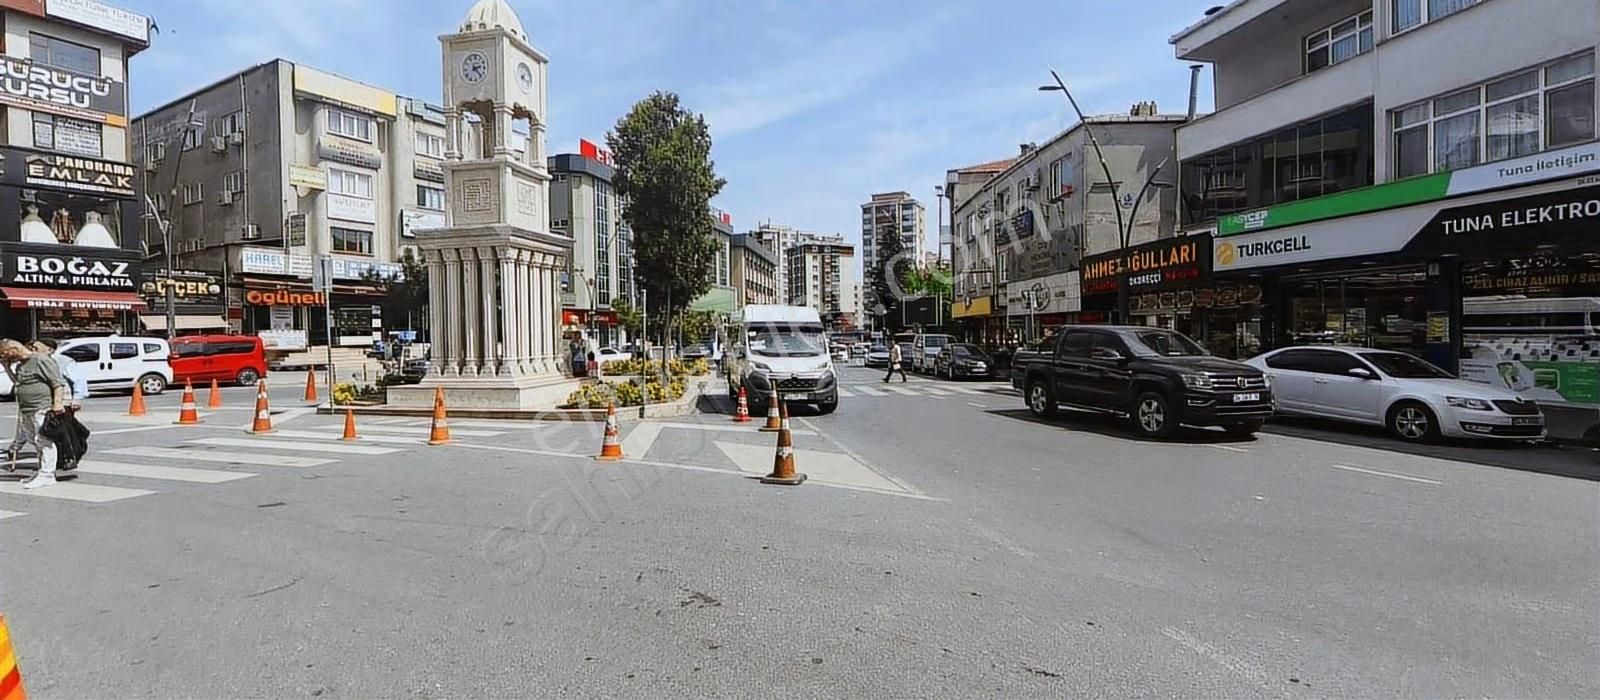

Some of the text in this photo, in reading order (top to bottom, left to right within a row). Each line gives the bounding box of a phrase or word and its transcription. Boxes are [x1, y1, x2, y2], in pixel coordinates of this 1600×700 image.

[29, 164, 132, 188] EMLAK
[56, 156, 134, 176] PANORAMA
[1498, 164, 1533, 178] Tuna
[1442, 200, 1600, 235] TUNA ELEKTRO
[1238, 236, 1311, 258] TURKCELL
[17, 256, 129, 277] BOĞAZ
[14, 273, 54, 283] ALTIN
[72, 276, 133, 287] PIRLANTA
